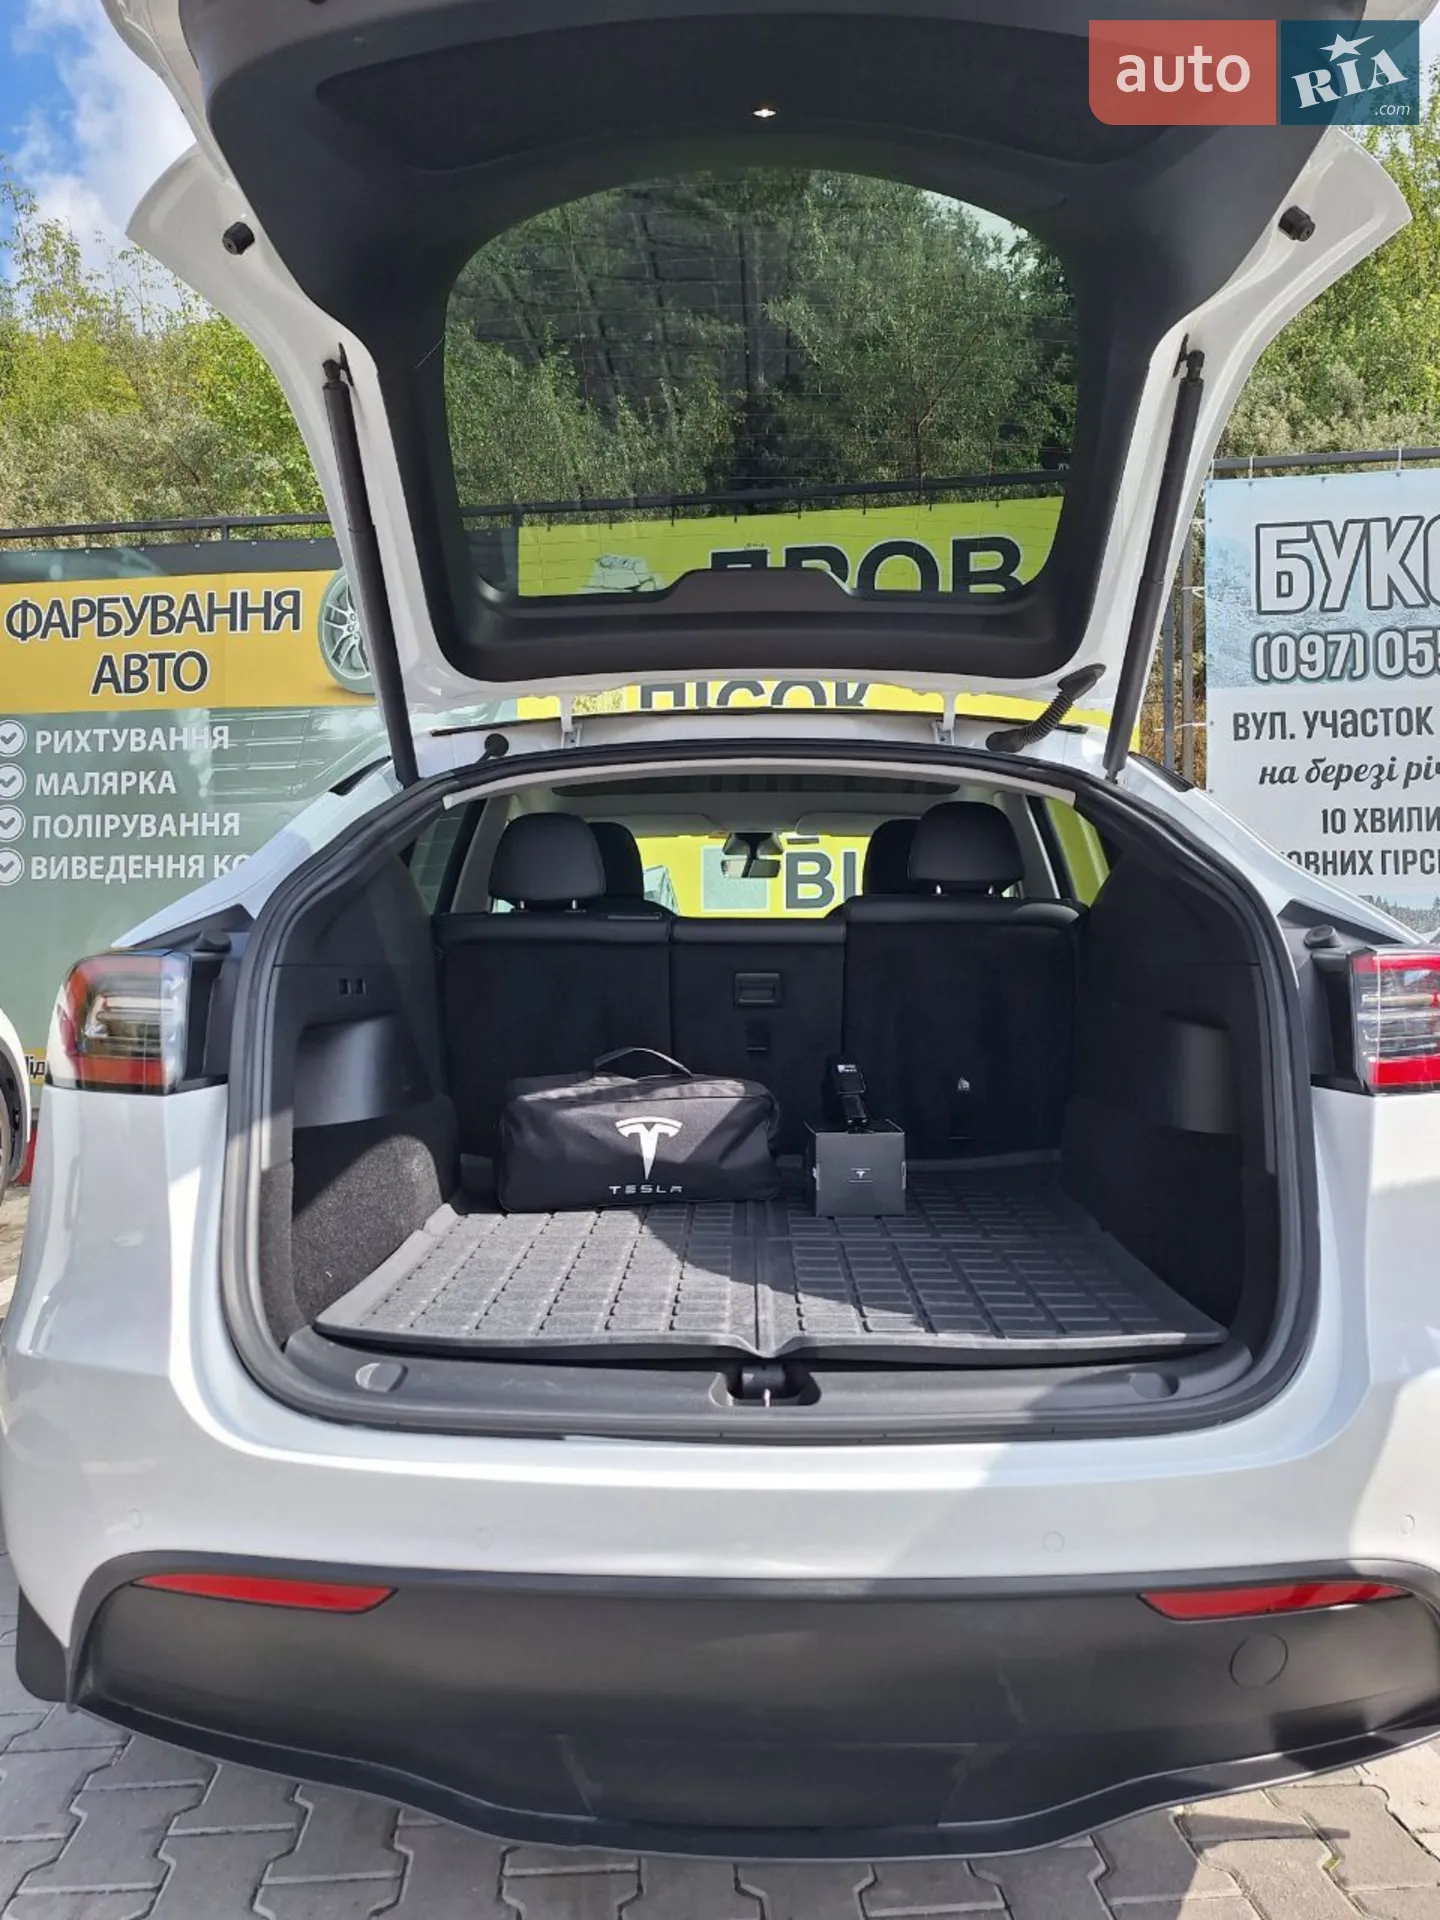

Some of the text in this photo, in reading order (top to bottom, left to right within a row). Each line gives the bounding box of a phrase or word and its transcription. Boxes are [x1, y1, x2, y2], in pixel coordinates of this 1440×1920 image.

[1255, 514, 1440, 616] БУК
[5, 589, 302, 642] ФАРБУВАННЯ
[1252, 626, 1440, 684] (097) 05
[91, 650, 209, 696] АВТО
[35, 725, 230, 754] РИХТУВАННЯ
[35, 771, 177, 797] МАЛЯРКА
[1258, 765, 1299, 785] на
[1305, 756, 1399, 791] березі
[32, 812, 241, 840] ПОЛІРУВАННЯ
[1321, 808, 1346, 834] 10
[30, 855, 205, 884] ВИВЕДЕННЯ
[1381, 849, 1440, 875] ГІРС
[609, 1184, 682, 1195] TESLA
